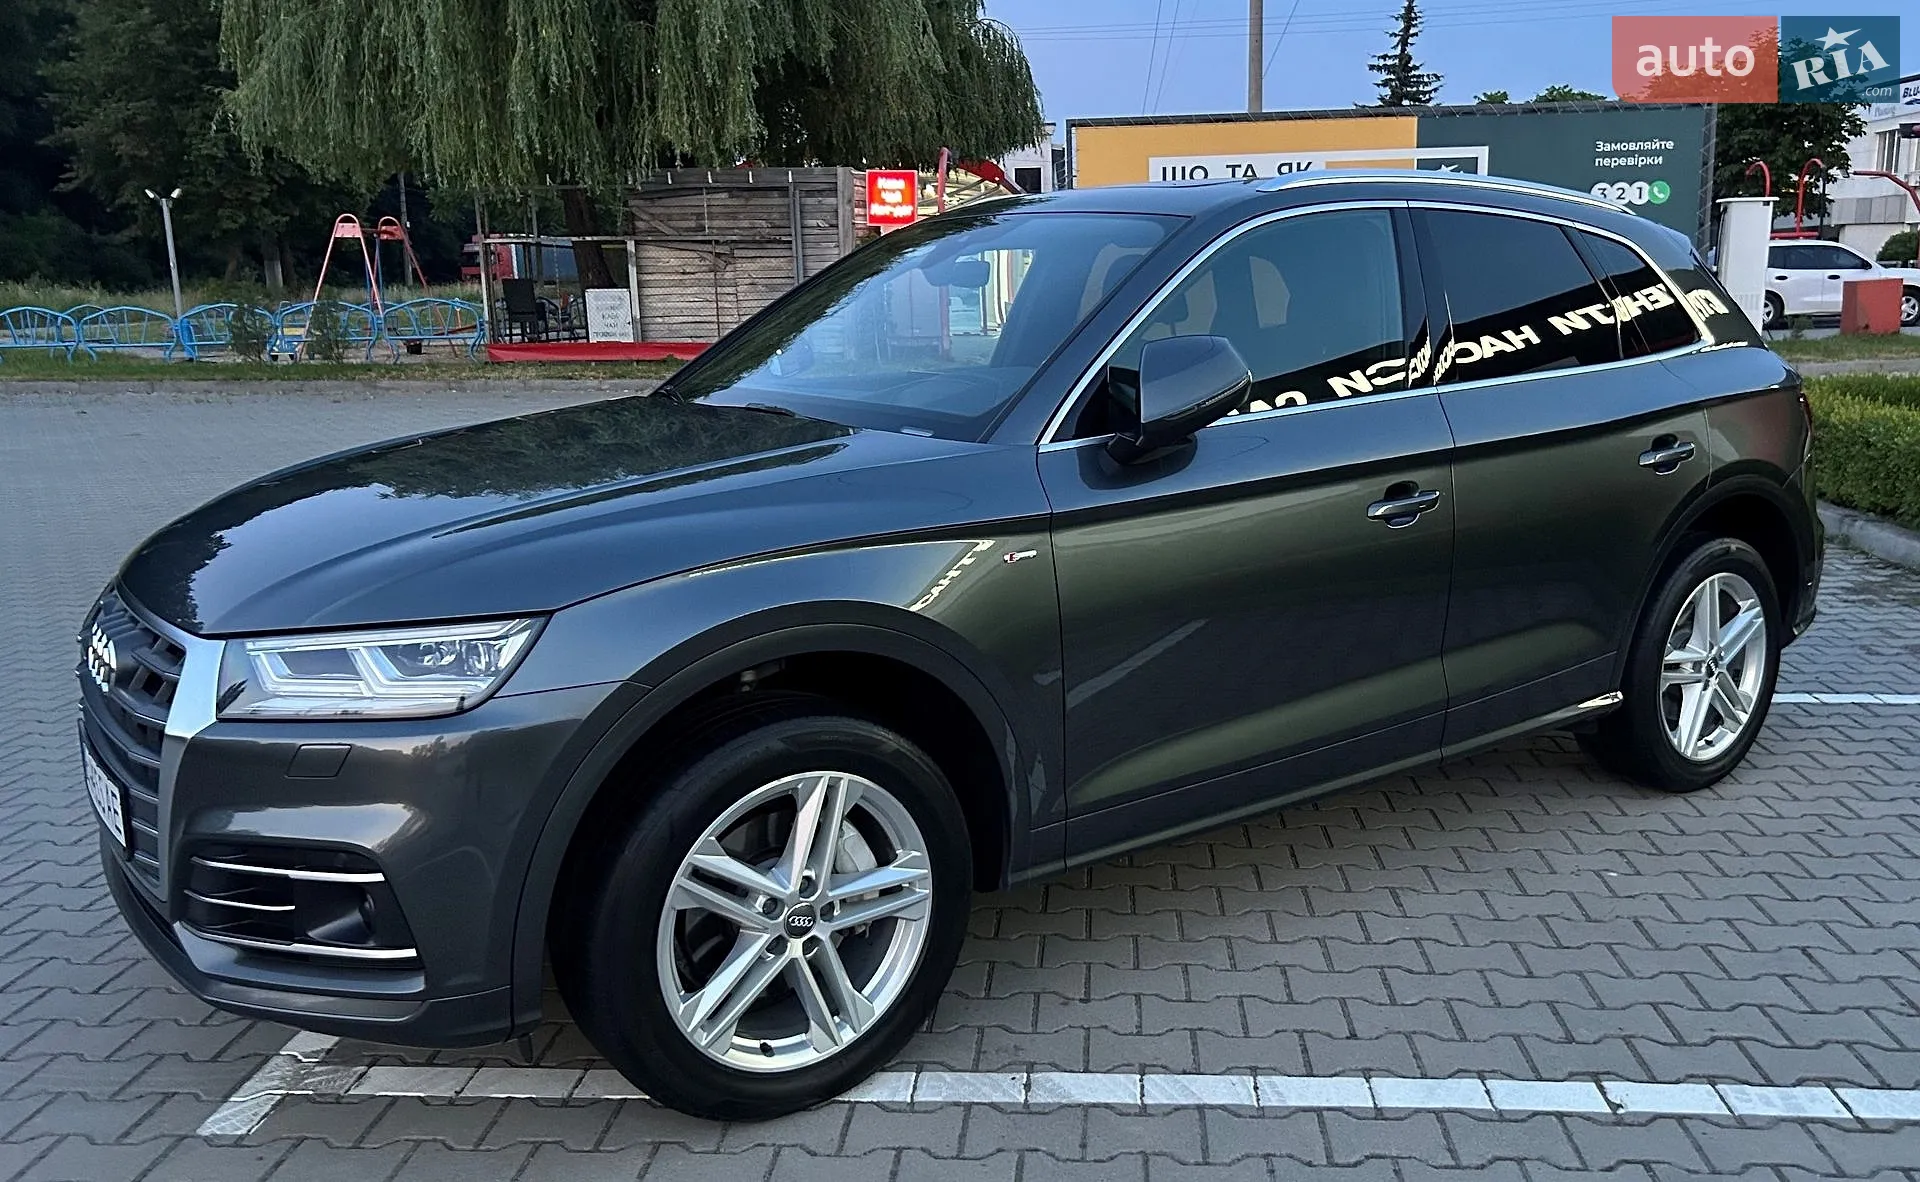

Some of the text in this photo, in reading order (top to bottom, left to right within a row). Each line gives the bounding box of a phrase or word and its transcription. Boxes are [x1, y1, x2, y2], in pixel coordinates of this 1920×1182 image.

[1595, 139, 1674, 152] Замовляйте
[1595, 153, 1663, 168] перевірки
[1226, 163, 1258, 178] ТА
